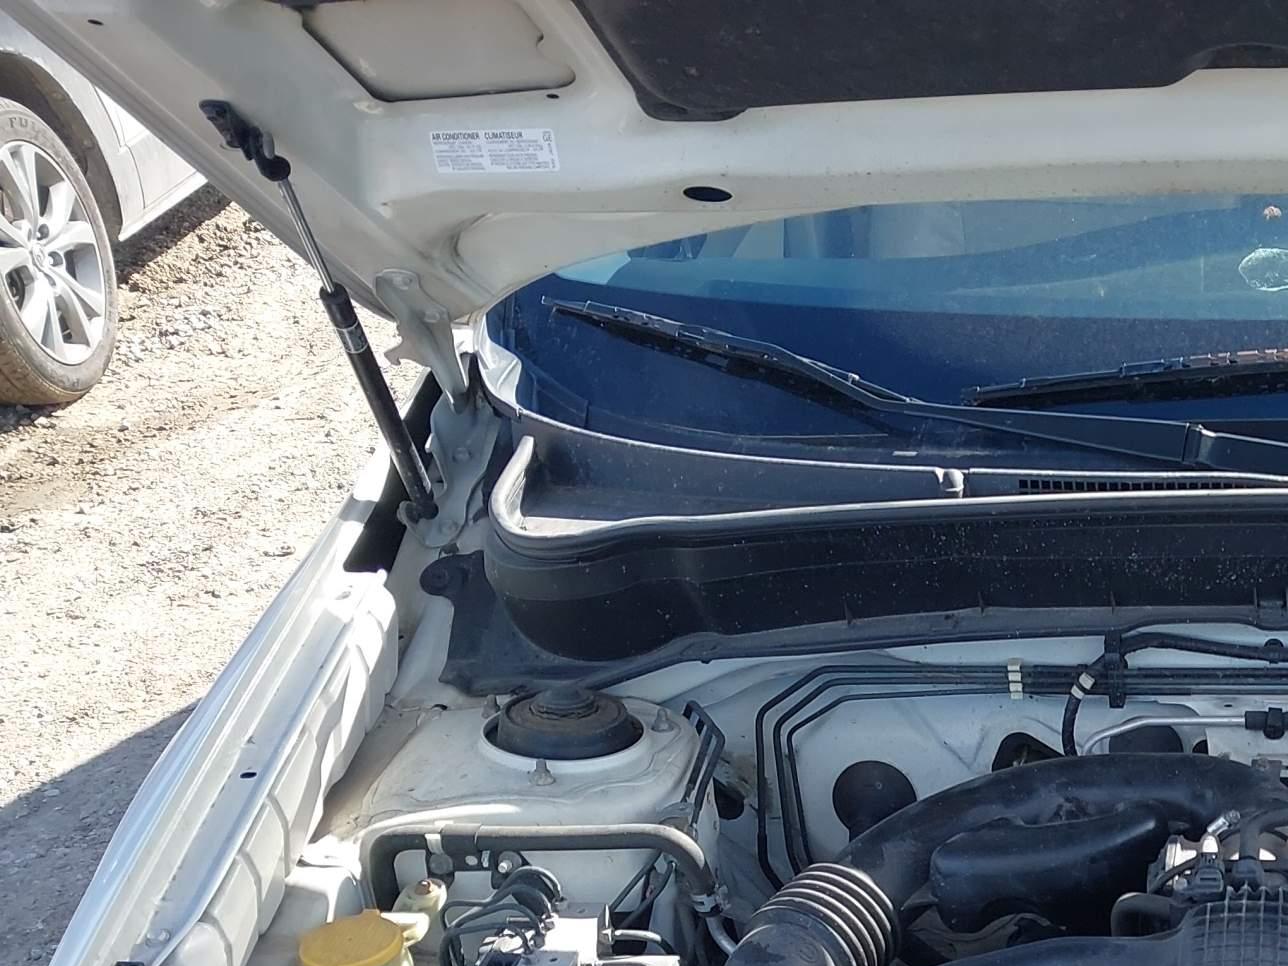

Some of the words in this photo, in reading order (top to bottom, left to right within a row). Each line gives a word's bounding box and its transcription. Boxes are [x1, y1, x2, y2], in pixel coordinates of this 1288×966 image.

[432, 132, 441, 140] AIR
[442, 132, 480, 141] CONDITIONER
[484, 131, 523, 140] CLIMATISEUR
